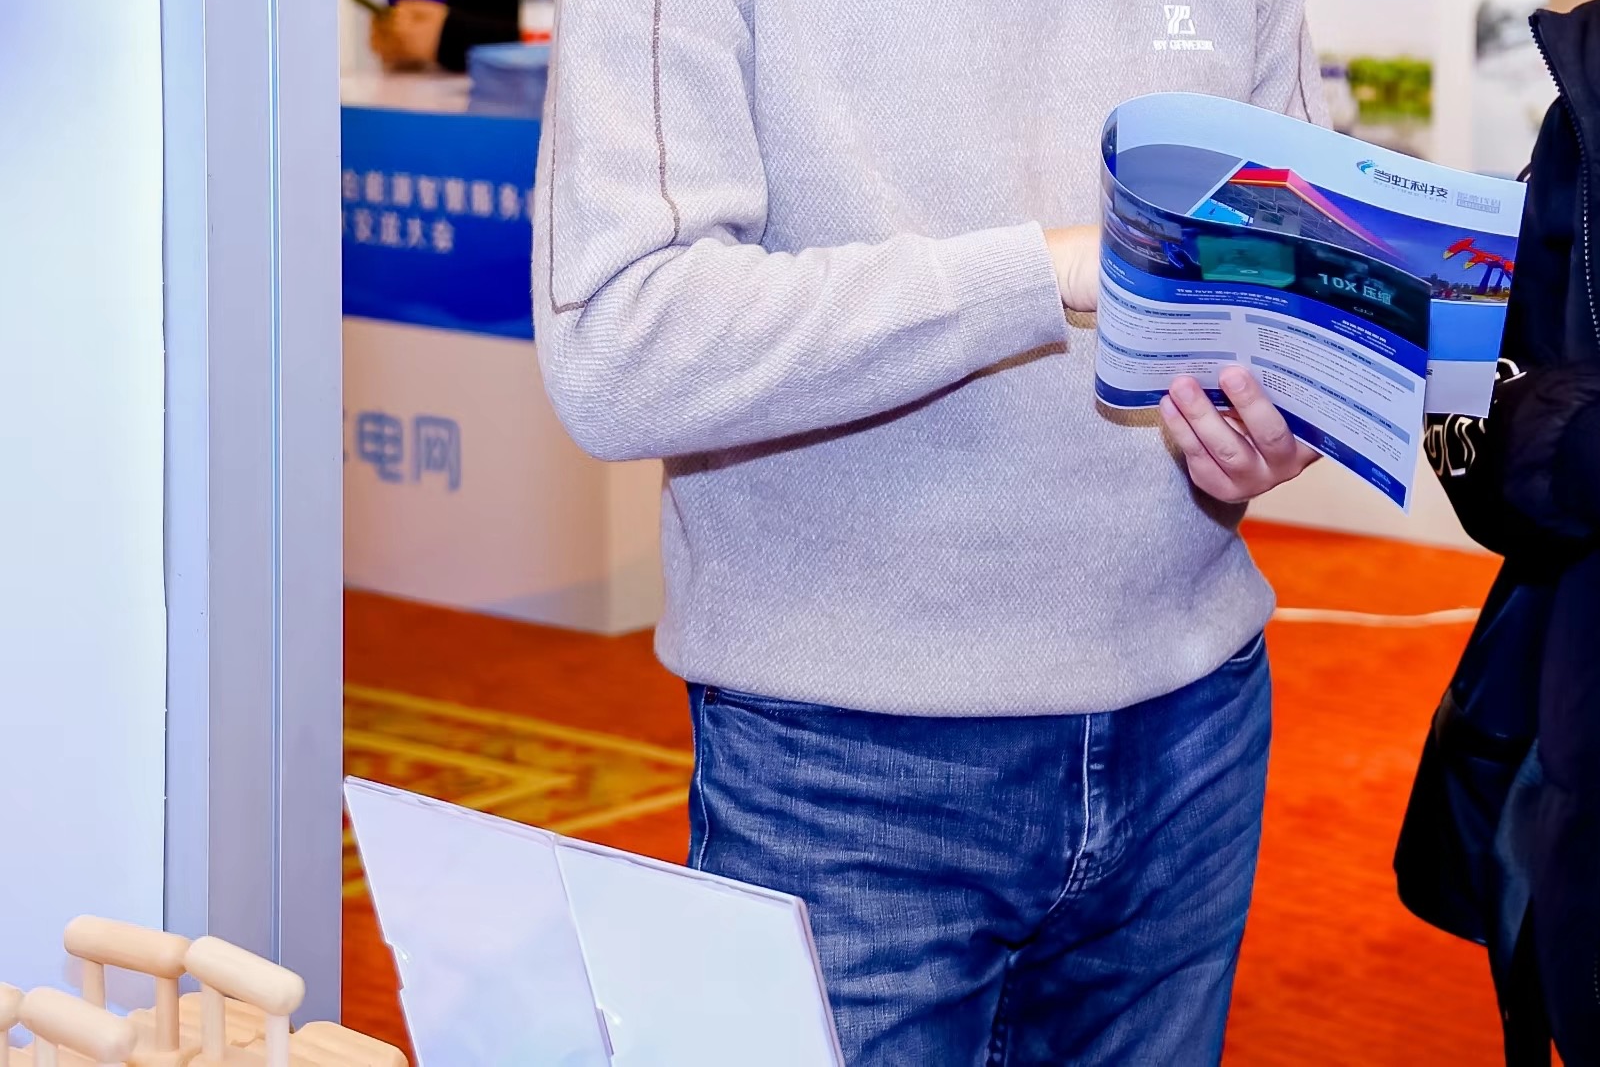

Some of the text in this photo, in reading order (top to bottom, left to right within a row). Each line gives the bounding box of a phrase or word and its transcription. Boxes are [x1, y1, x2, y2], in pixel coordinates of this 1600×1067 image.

[1373, 168, 1449, 200] 当虹科技
[1318, 273, 1358, 294] 10X
[342, 410, 462, 493] 电网
